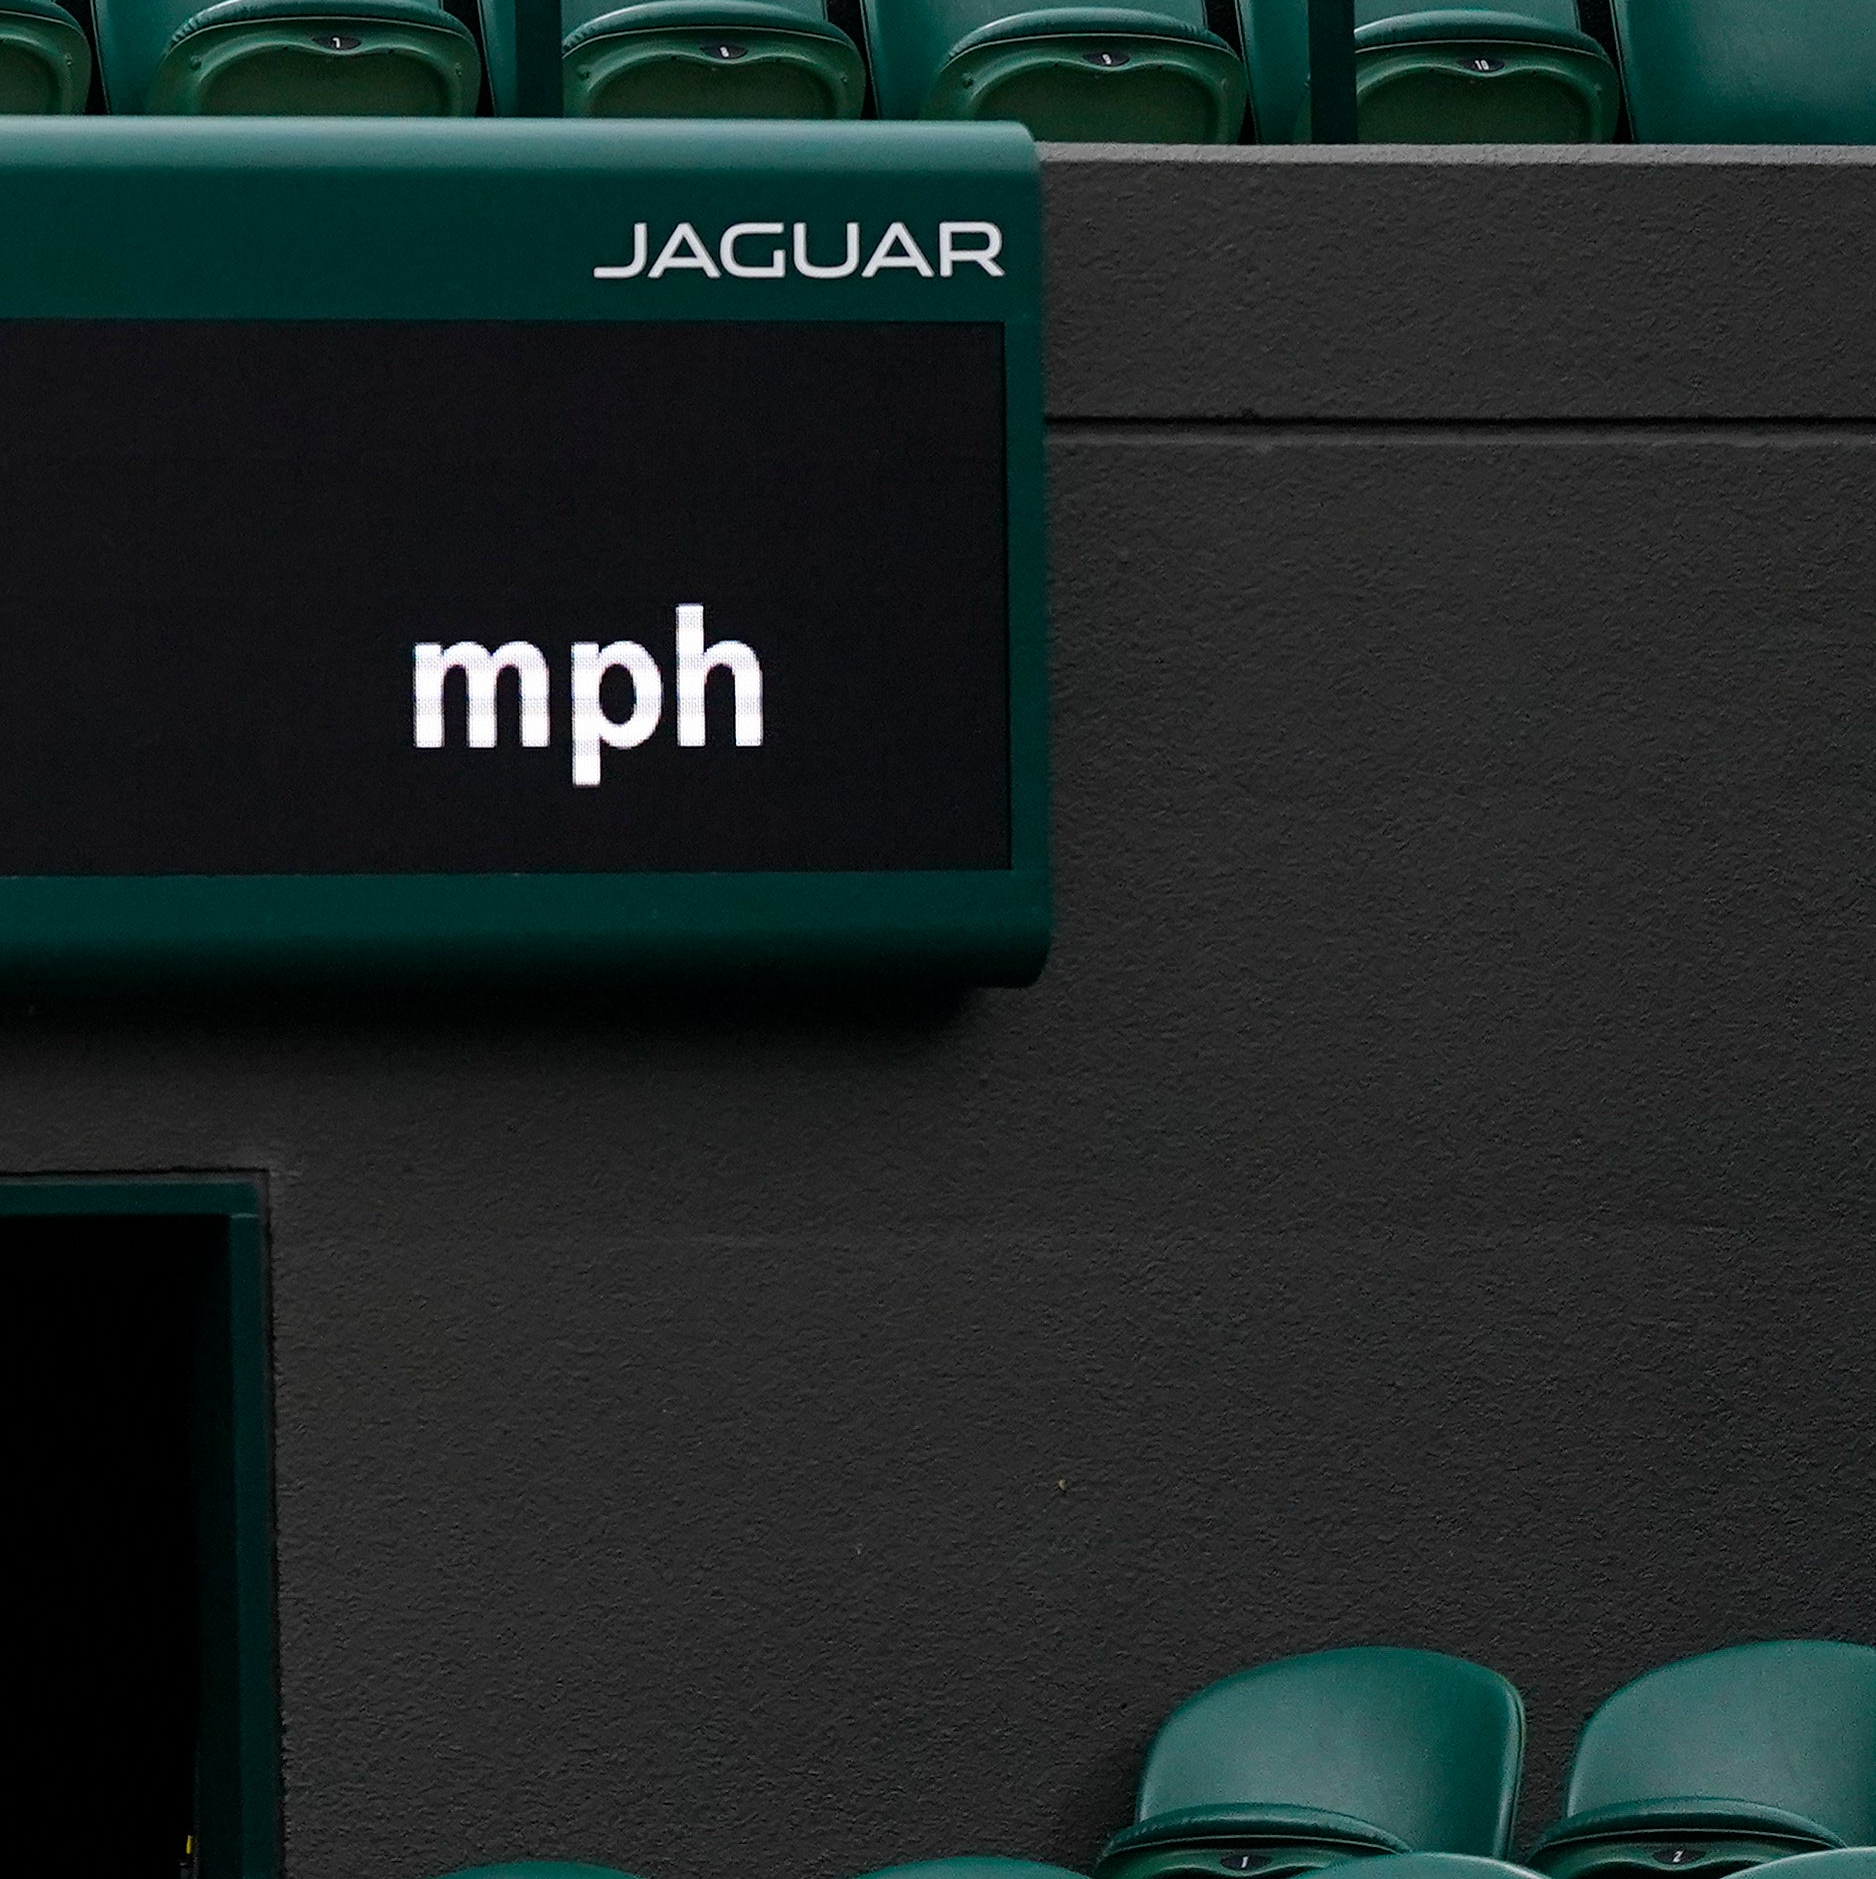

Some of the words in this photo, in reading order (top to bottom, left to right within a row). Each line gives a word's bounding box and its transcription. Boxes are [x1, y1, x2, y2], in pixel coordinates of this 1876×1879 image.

[332, 37, 340, 48] 7
[1475, 59, 1489, 71] 10
[593, 221, 1004, 279] JAGUAR
[412, 603, 765, 786] mph
[1673, 1850, 1683, 1862] 2
